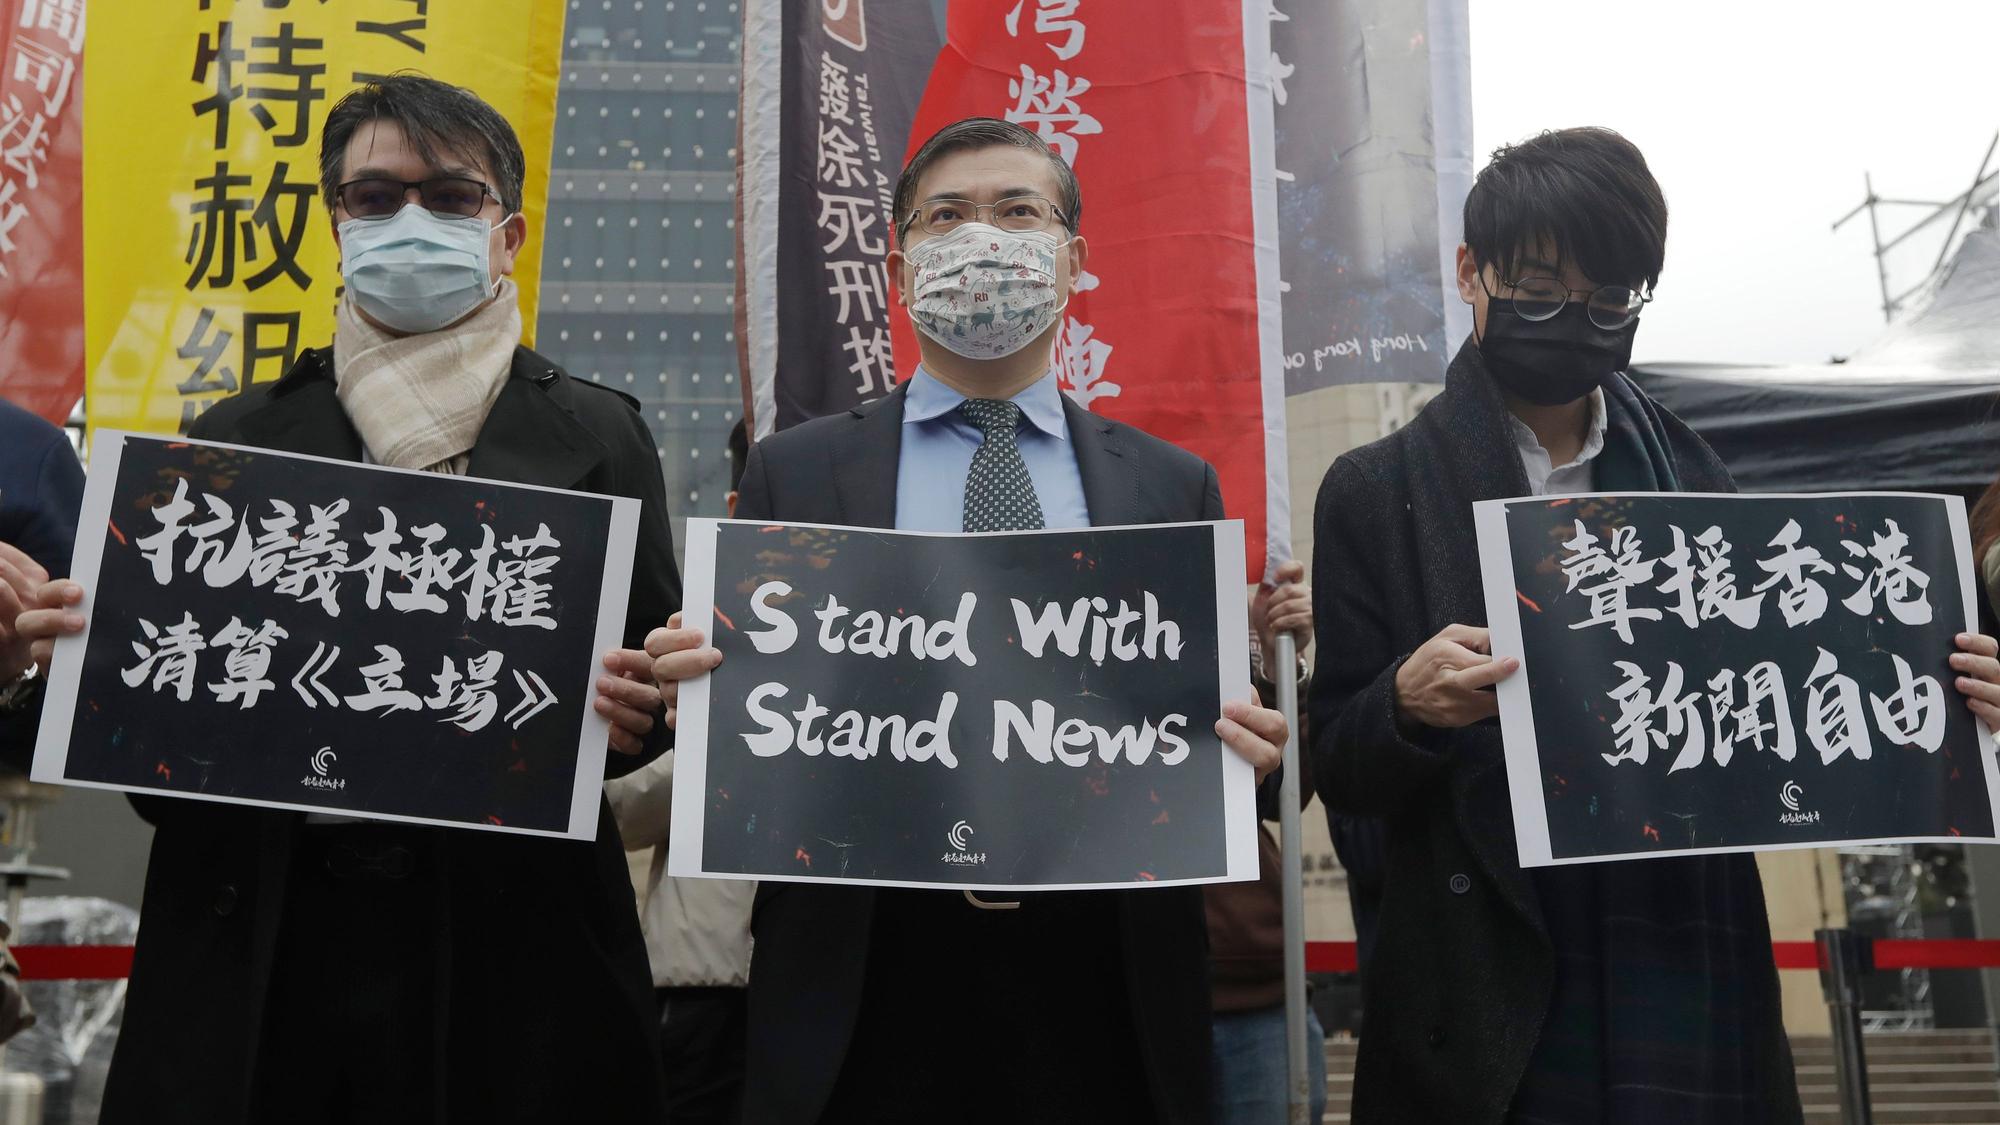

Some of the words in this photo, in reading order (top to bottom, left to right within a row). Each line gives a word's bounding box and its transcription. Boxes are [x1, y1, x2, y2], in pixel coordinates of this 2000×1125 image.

[854, 72, 882, 163] Taiwan
[174, 0, 329, 434] 特赦組
[136, 477, 562, 631] 抗議極權
[1559, 518, 1934, 645] 聲援香港
[120, 611, 560, 732] 清算《立場》
[744, 581, 977, 667] Stand
[1010, 590, 1187, 667] With
[738, 682, 958, 769] Stand
[991, 699, 1191, 768] News
[1600, 646, 1948, 775] 新聞自由
